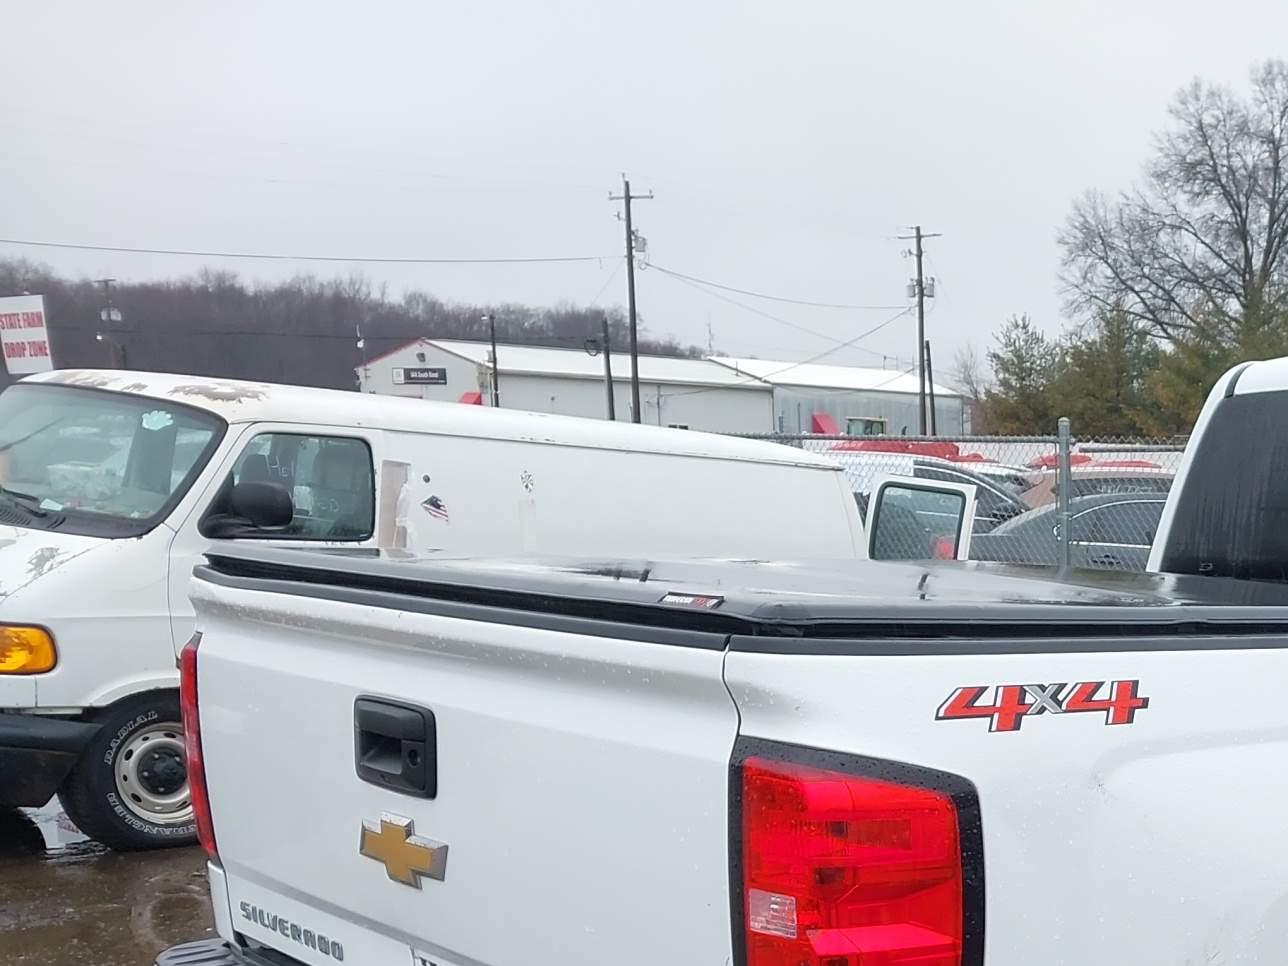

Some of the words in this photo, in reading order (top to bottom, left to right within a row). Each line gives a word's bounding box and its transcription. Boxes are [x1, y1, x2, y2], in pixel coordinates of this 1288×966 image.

[0, 312, 22, 330] STATE
[22, 311, 44, 328] FARM
[4, 342, 26, 358] DROP
[27, 341, 48, 357] ZONE
[104, 711, 158, 765] RADIAL
[240, 901, 344, 962] SILVERADO
